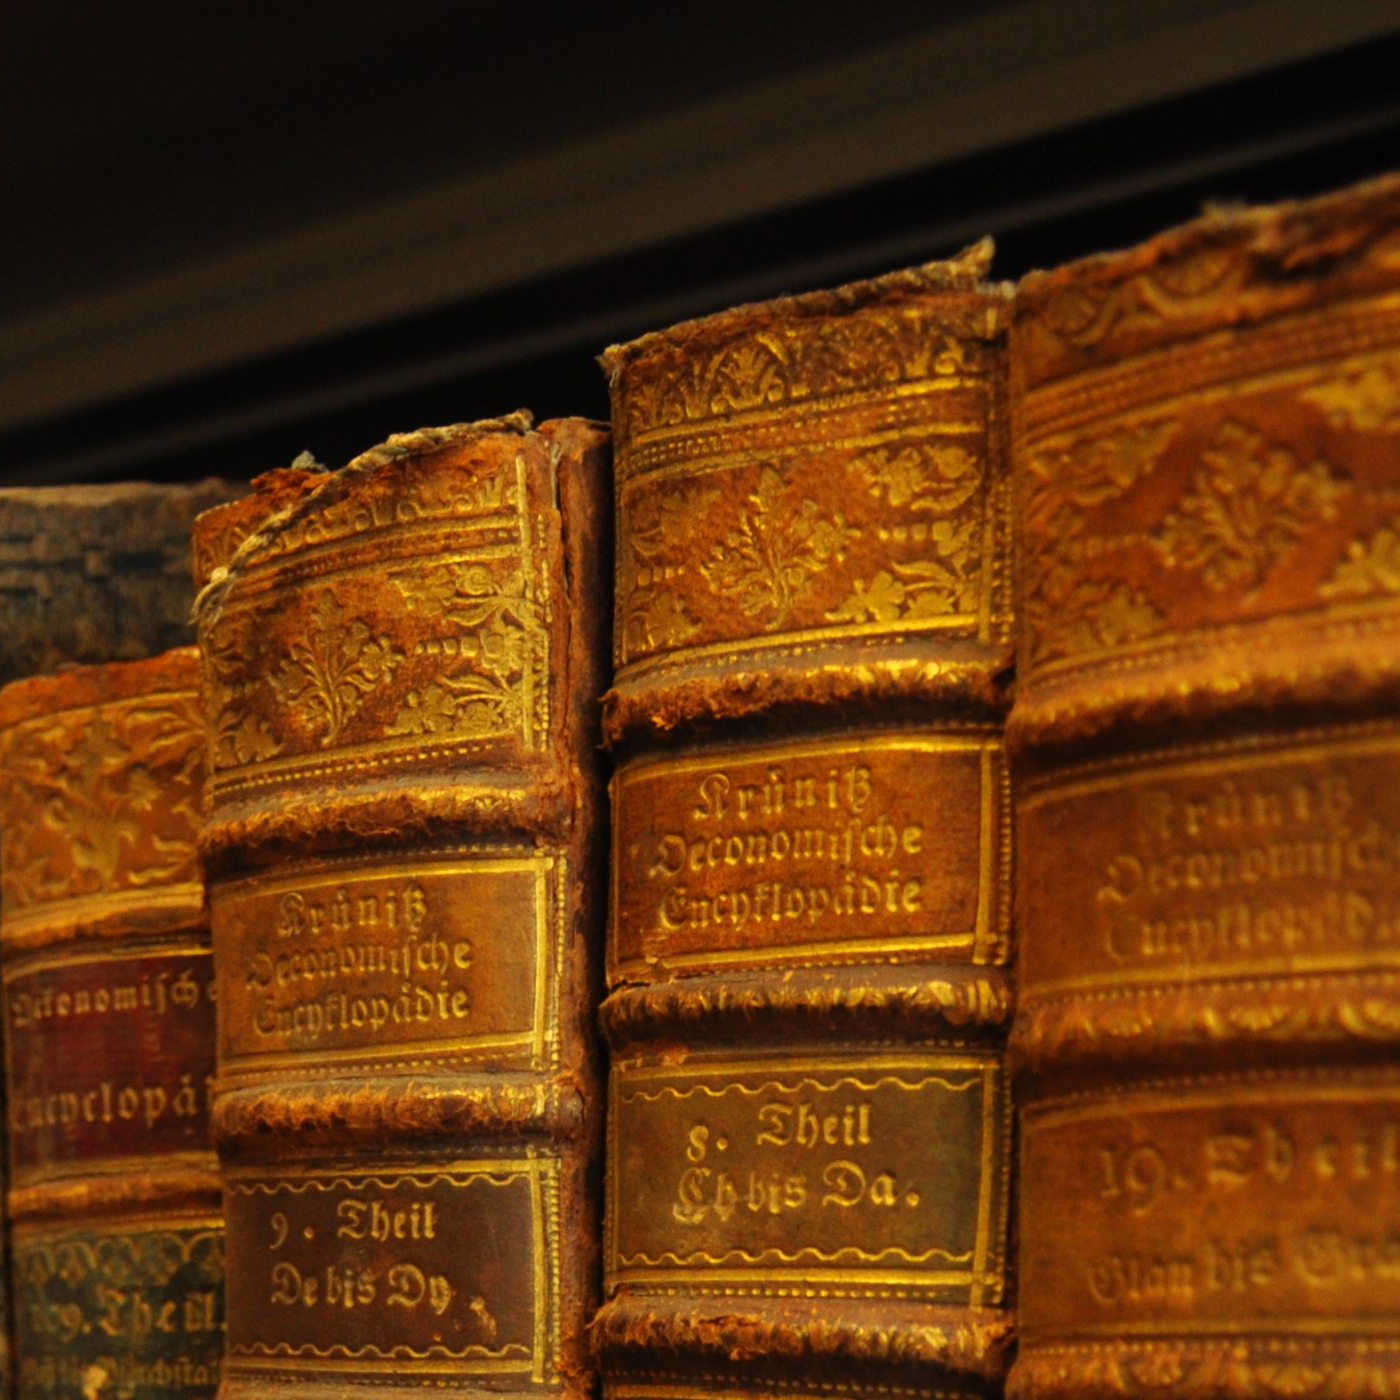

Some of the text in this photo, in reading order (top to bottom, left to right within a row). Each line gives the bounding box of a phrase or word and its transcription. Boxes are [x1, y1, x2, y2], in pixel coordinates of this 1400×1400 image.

[756, 1104, 872, 1148] Theil
[748, 1170, 808, 1216] bis
[337, 1199, 437, 1241] Theil
